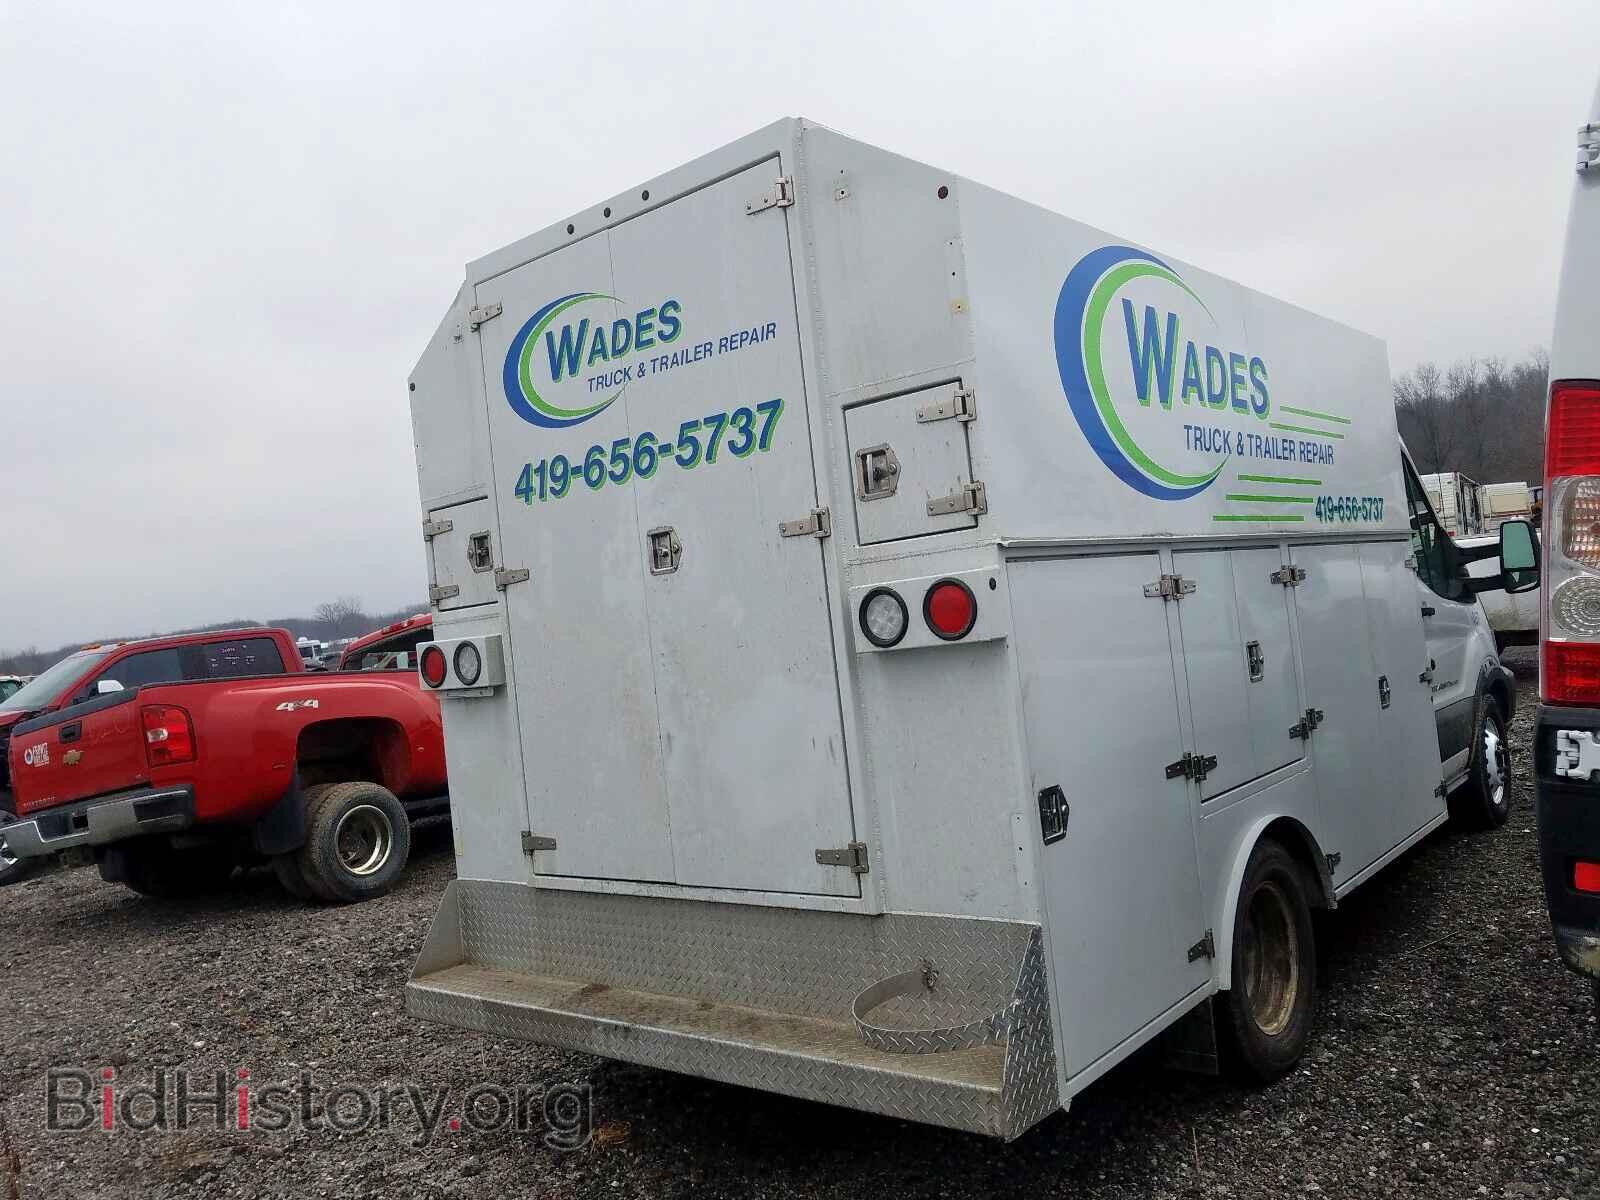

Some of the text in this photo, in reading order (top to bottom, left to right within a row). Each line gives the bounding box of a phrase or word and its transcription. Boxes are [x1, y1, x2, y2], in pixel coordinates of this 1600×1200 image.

[587, 322, 777, 393] TRUCK & TRAILER REPAIR
[514, 398, 785, 506] 419-656-5737
[1183, 424, 1335, 465] TRUCK & TRAILER REPAIR
[1315, 495, 1384, 523] 419-656-5737
